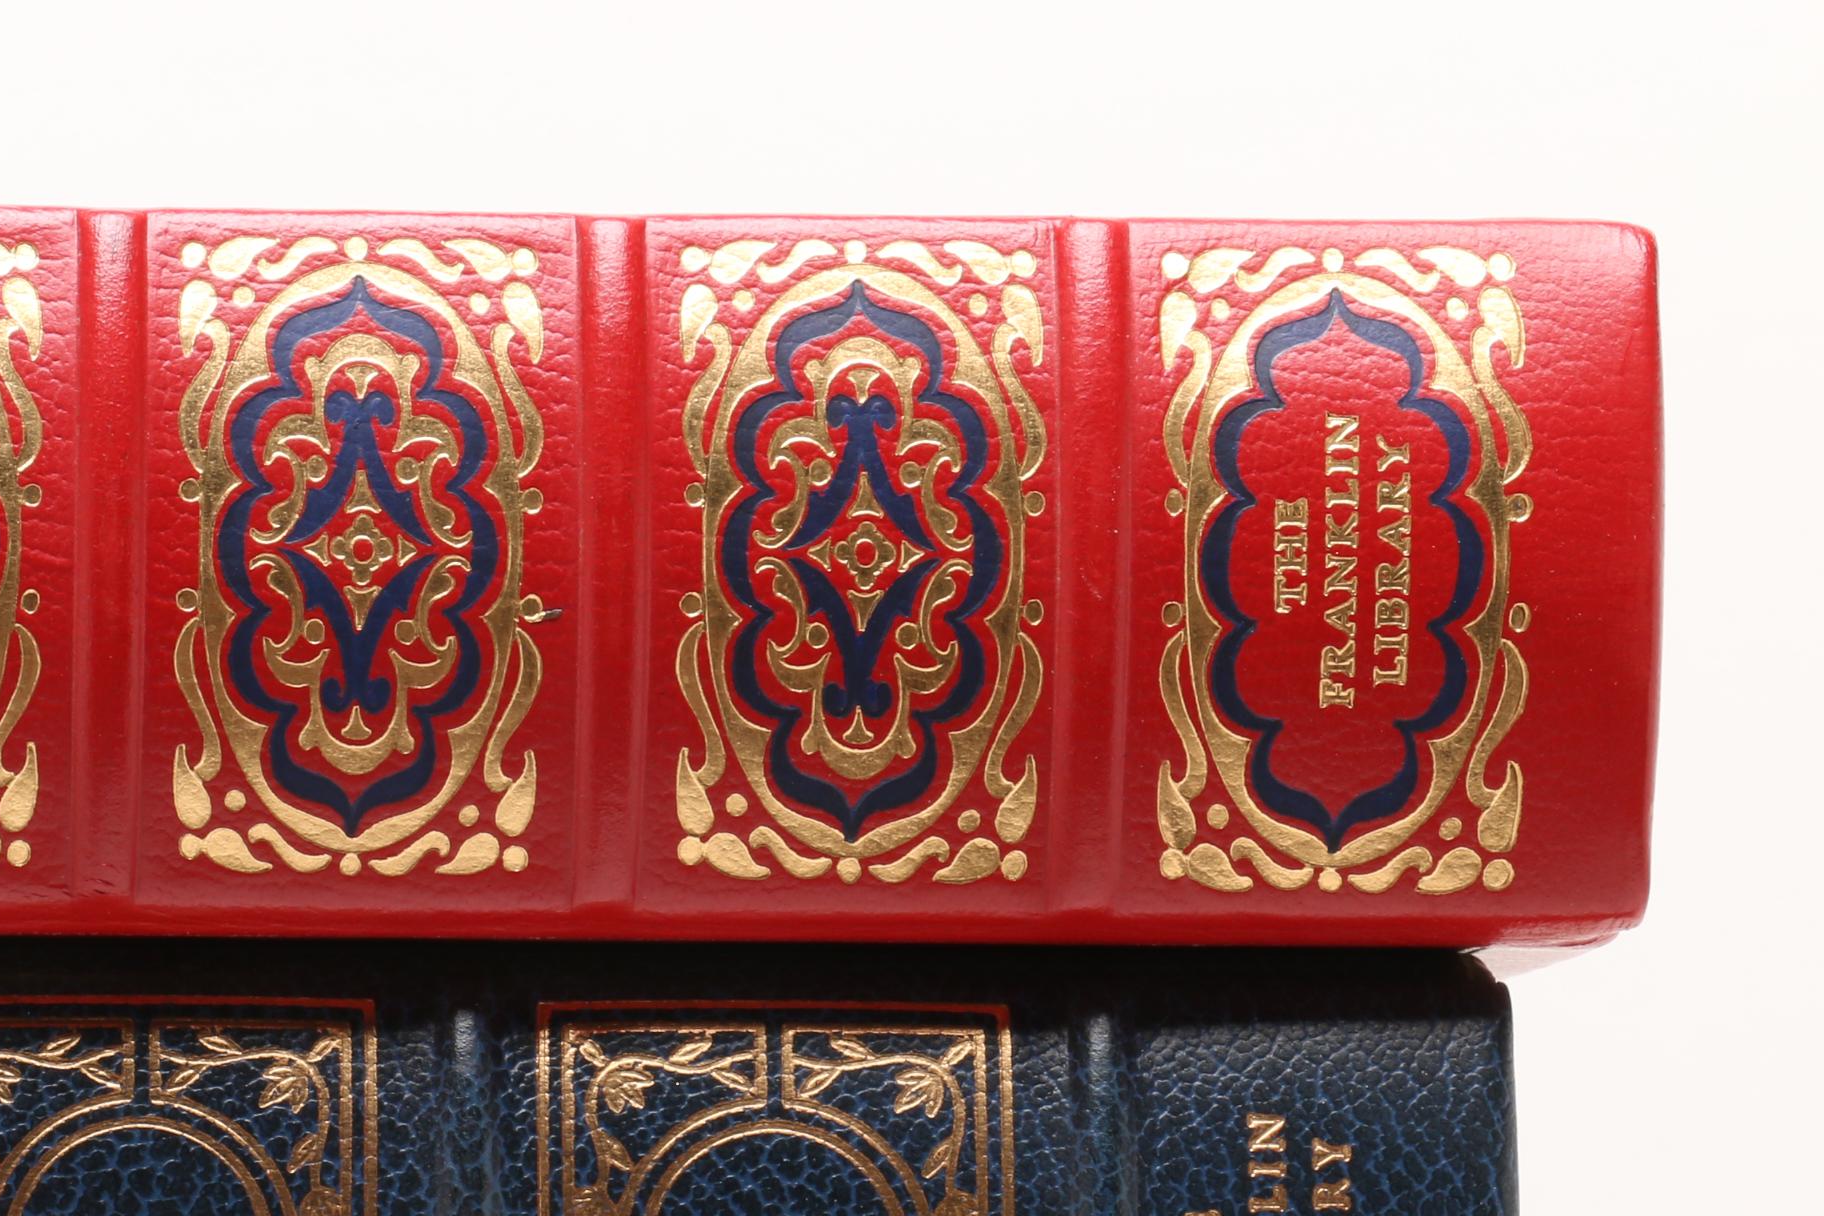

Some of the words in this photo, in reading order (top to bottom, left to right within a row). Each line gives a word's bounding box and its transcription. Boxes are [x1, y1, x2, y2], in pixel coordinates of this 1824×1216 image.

[1274, 497, 1310, 614] THE
[1319, 410, 1361, 709] FRANKLIN
[1372, 435, 1414, 687] LIBRARY
